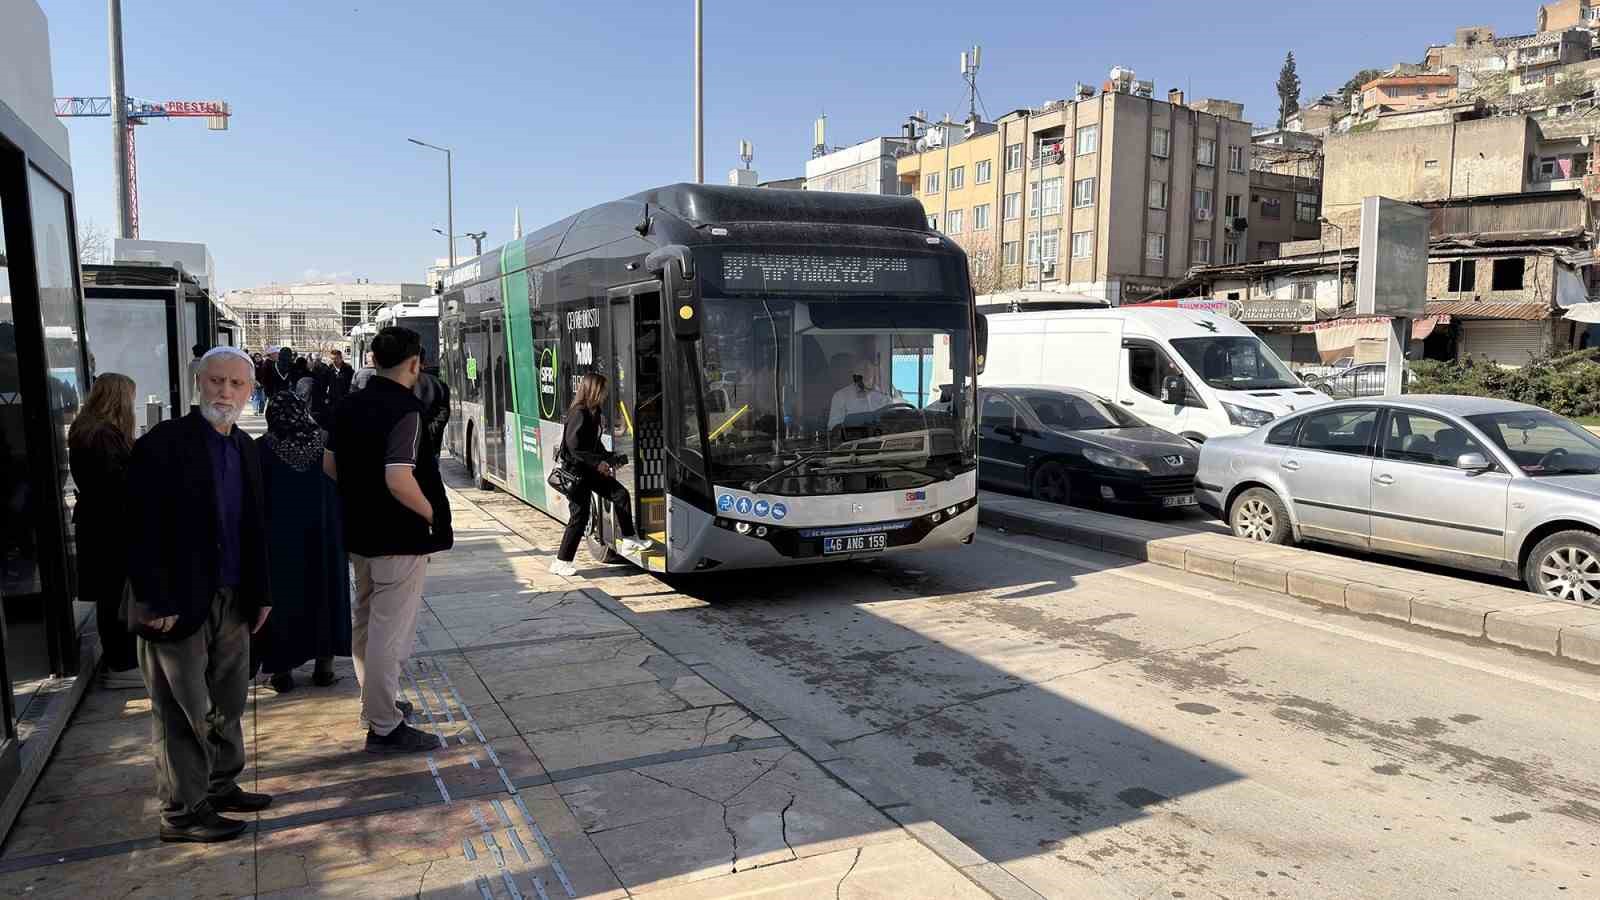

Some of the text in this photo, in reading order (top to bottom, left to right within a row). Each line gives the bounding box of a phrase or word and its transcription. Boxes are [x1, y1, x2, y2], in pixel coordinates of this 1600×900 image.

[830, 535, 885, 550] 46 ANG 159
